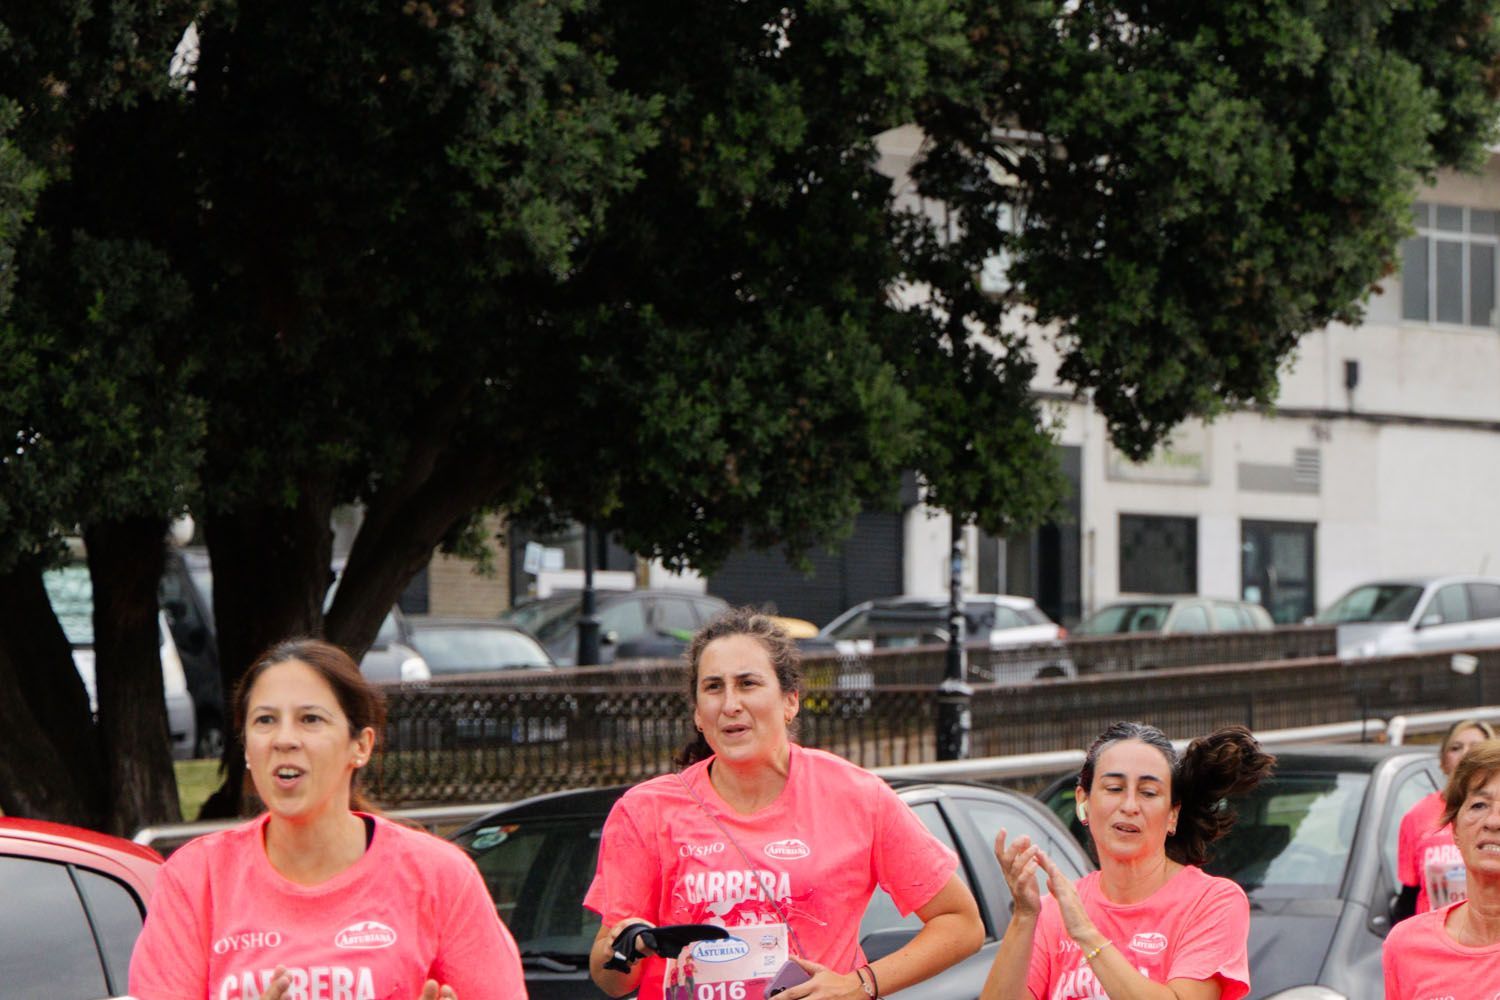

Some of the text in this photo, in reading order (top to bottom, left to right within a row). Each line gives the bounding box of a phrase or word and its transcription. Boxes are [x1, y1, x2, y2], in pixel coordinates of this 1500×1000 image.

[680, 842, 725, 857] OYSHO
[685, 870, 793, 905] CARRERA
[1449, 892, 1465, 903] 01
[214, 932, 281, 954] OYSHO
[340, 932, 393, 946] ASTURIANA
[697, 946, 746, 958] ASTURIANA
